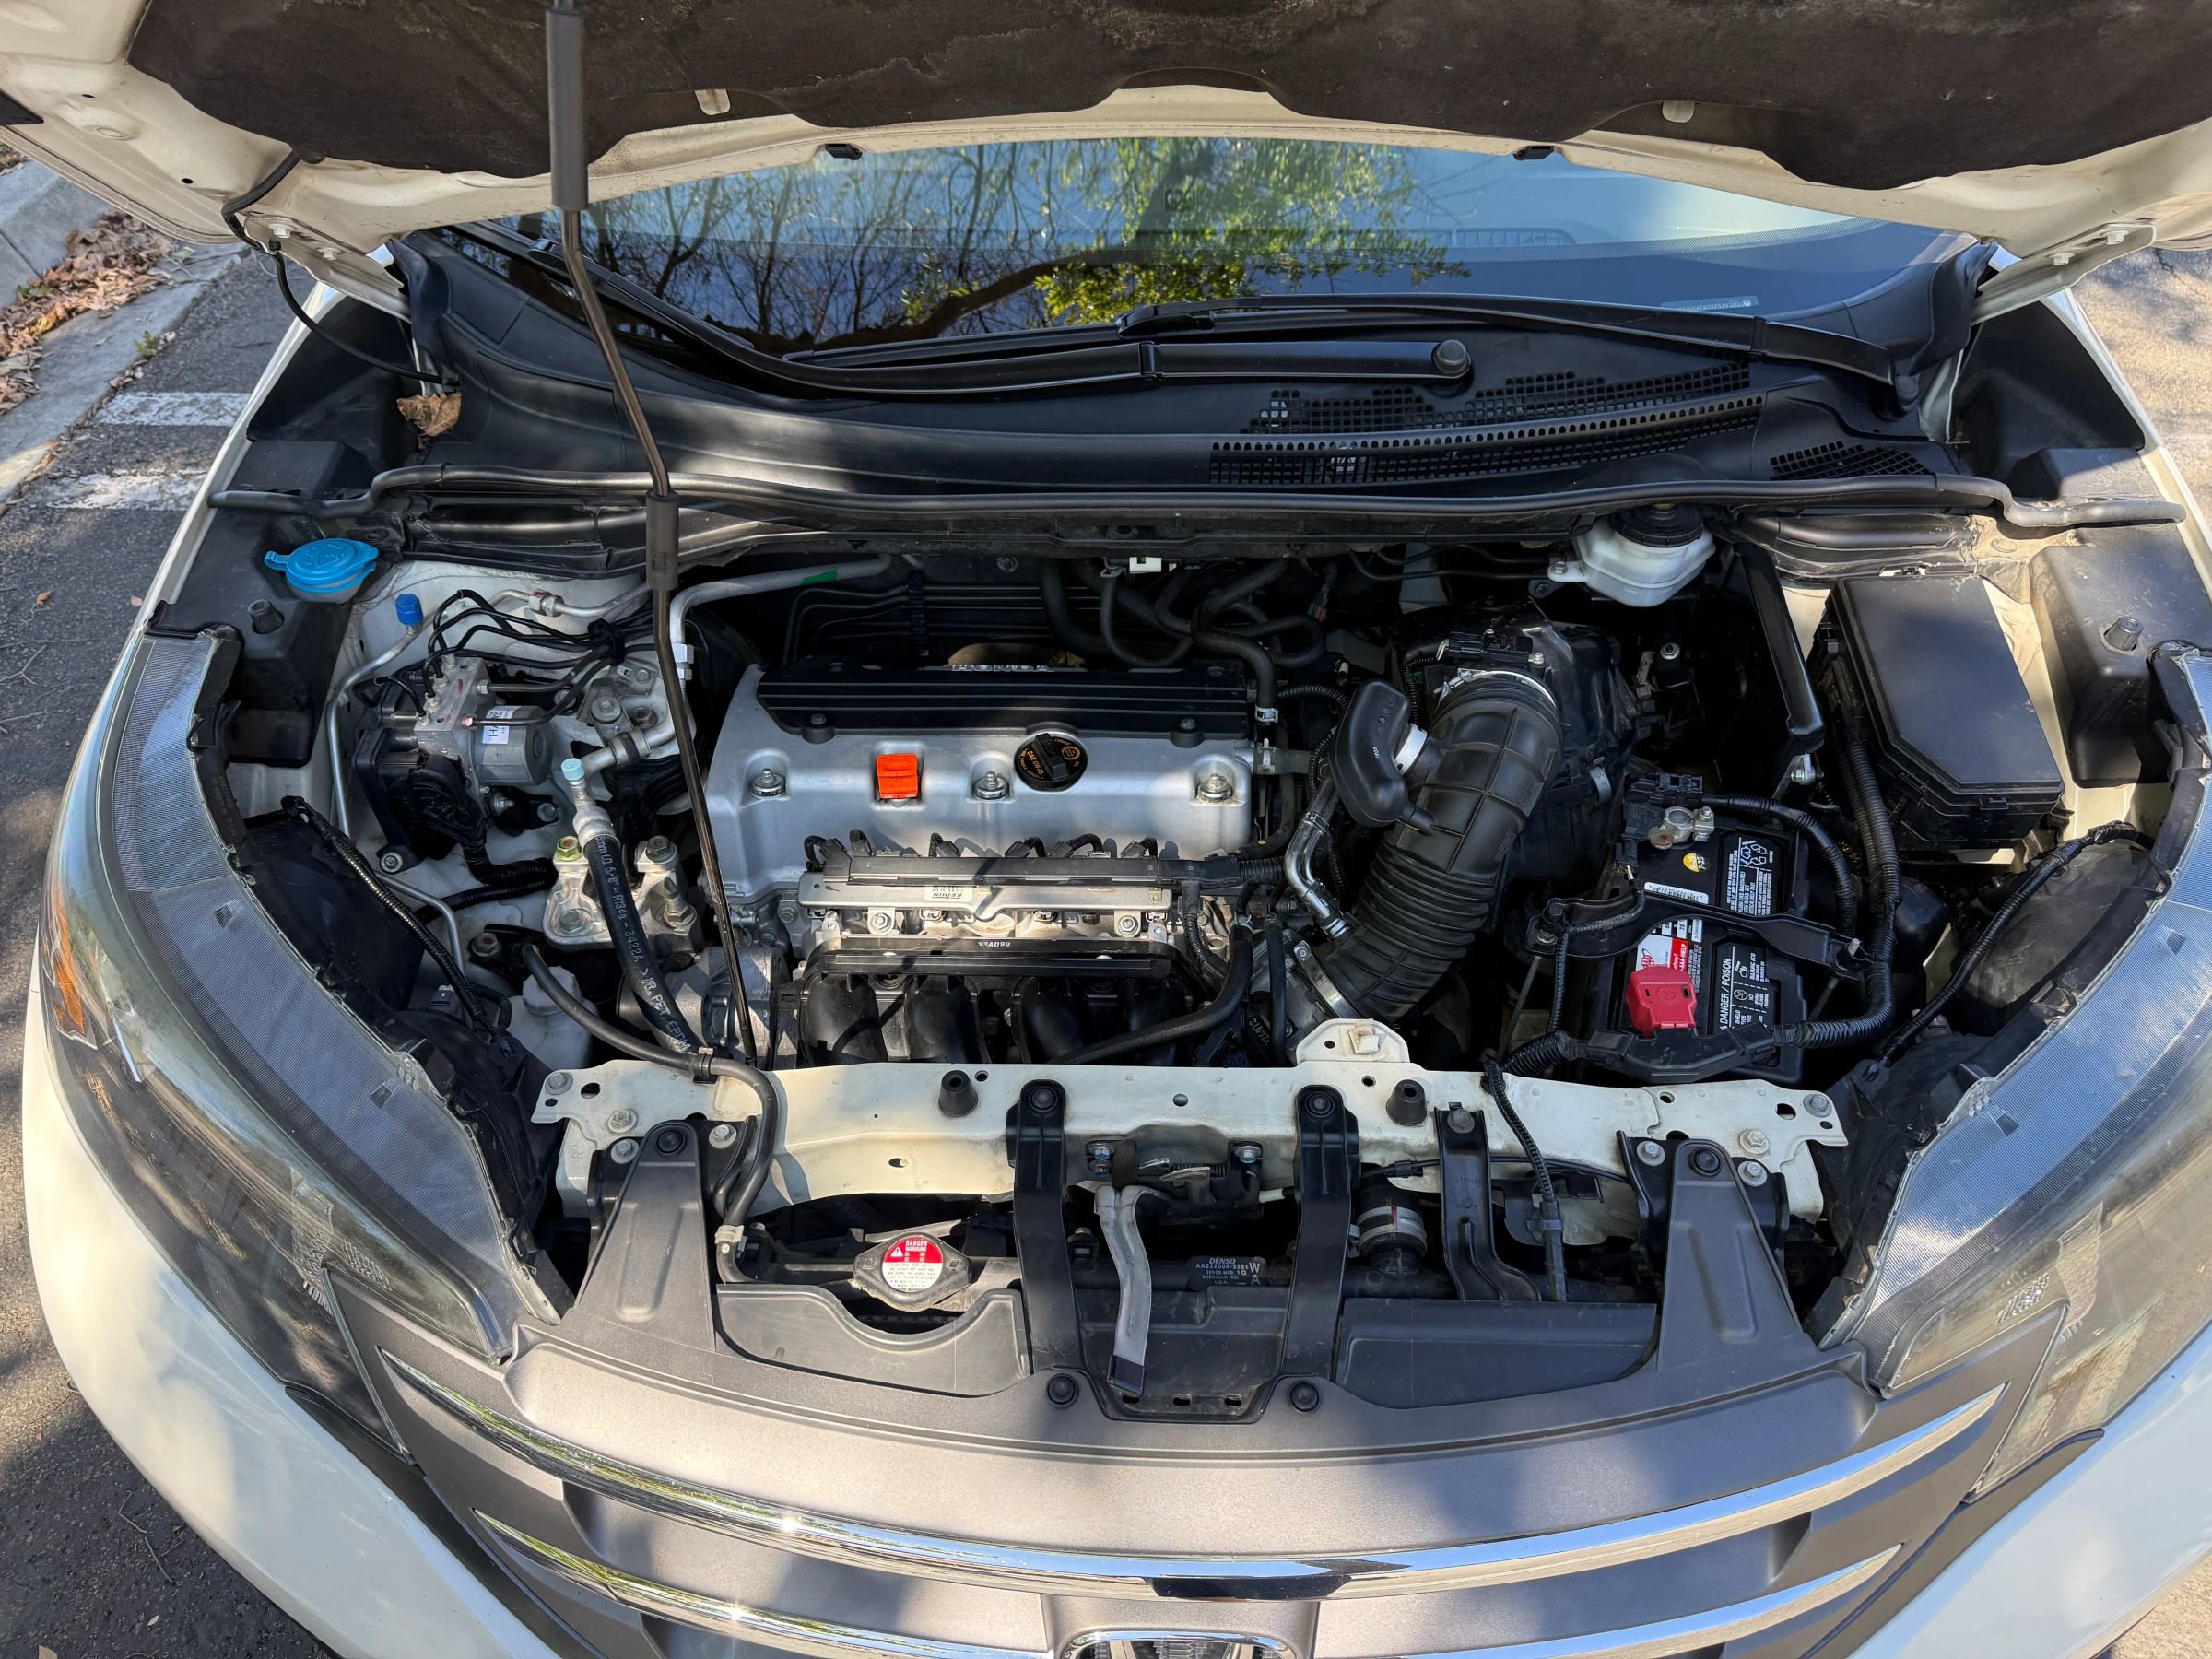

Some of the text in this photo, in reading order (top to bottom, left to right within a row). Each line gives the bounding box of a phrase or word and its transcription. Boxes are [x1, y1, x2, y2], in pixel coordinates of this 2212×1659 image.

[1028, 751, 1037, 761] SAE
[624, 929, 644, 963] 3422A
[1722, 958, 1731, 986] POISON
[1721, 994, 1729, 1024] DANGER
[1249, 1262, 1260, 1274] W
[1251, 1274, 1261, 1285] A
